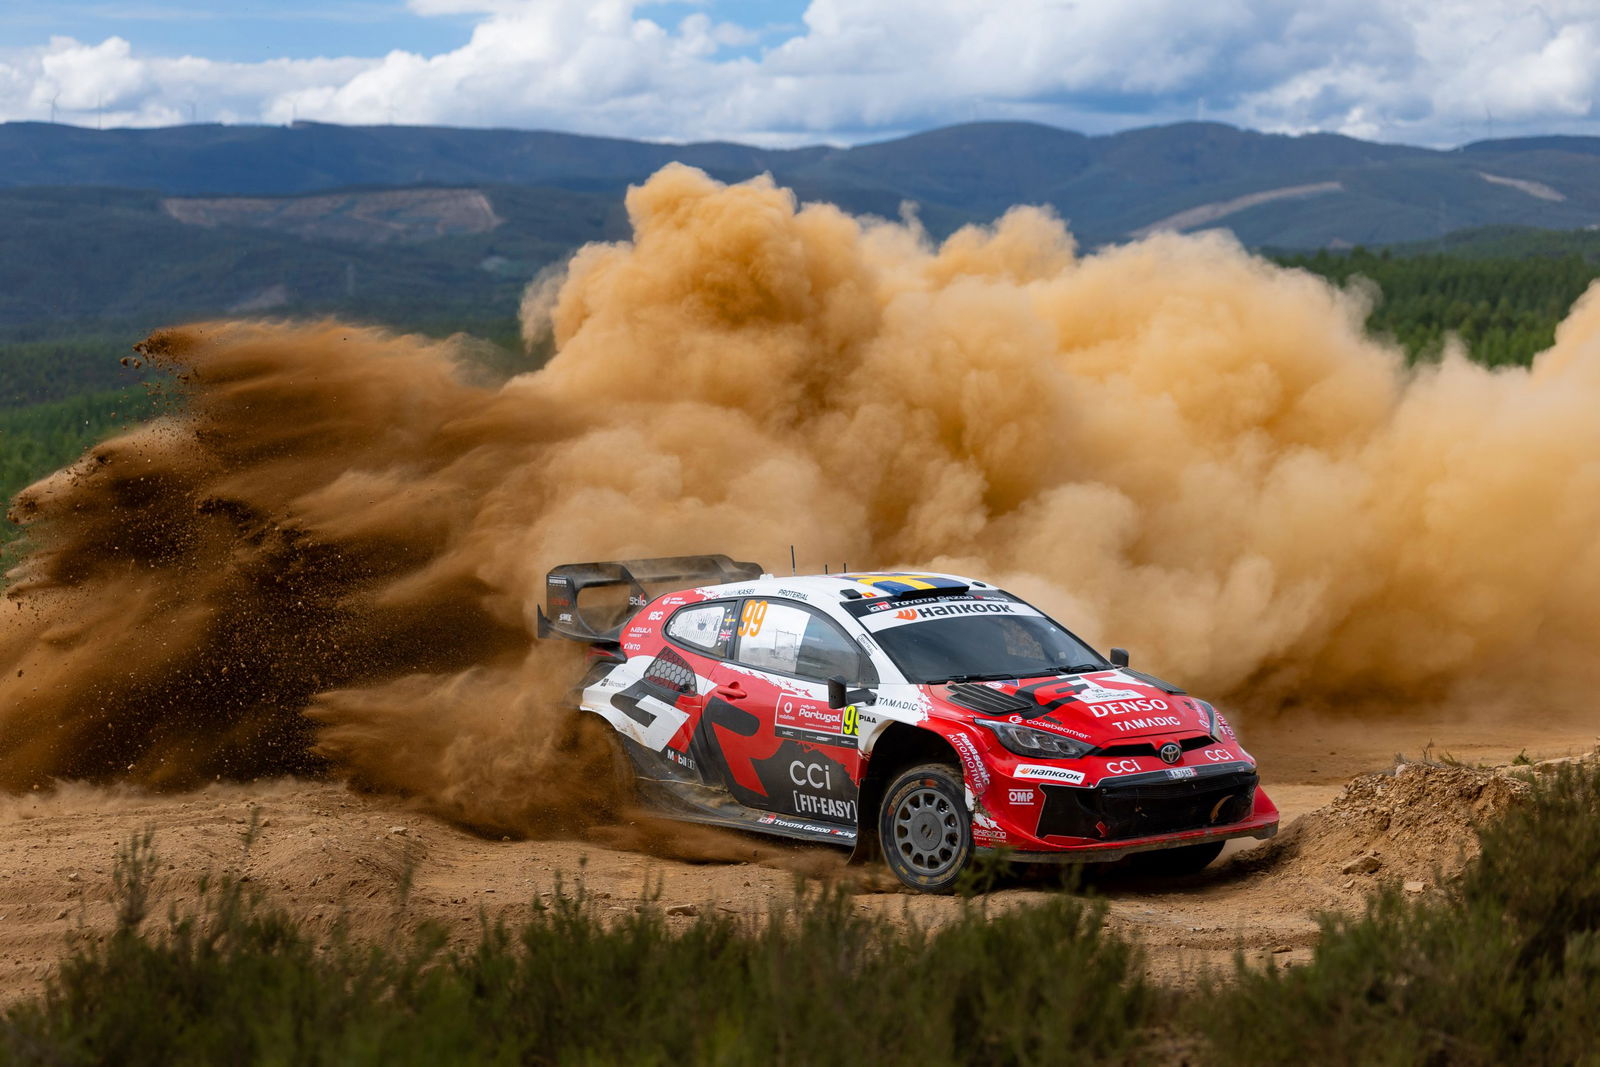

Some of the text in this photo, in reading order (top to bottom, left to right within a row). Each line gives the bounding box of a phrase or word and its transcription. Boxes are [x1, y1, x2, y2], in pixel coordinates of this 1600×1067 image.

[777, 588, 809, 601] PROTERIAL
[892, 597, 937, 608] TOYOTA
[738, 600, 768, 637] 99
[879, 697, 919, 711] TAMADIC
[1088, 699, 1169, 718] DENSO
[798, 709, 841, 722] Portugal
[859, 714, 877, 724] PIAA
[1112, 716, 1181, 731] TAMADIC
[946, 734, 984, 789] AUTOMOTIVE
[956, 732, 991, 785] Panasonic
[789, 760, 831, 790] CCi
[1008, 791, 1034, 803] OMP
[774, 818, 804, 829] TOYOTA
[803, 824, 831, 834] GAZOO
